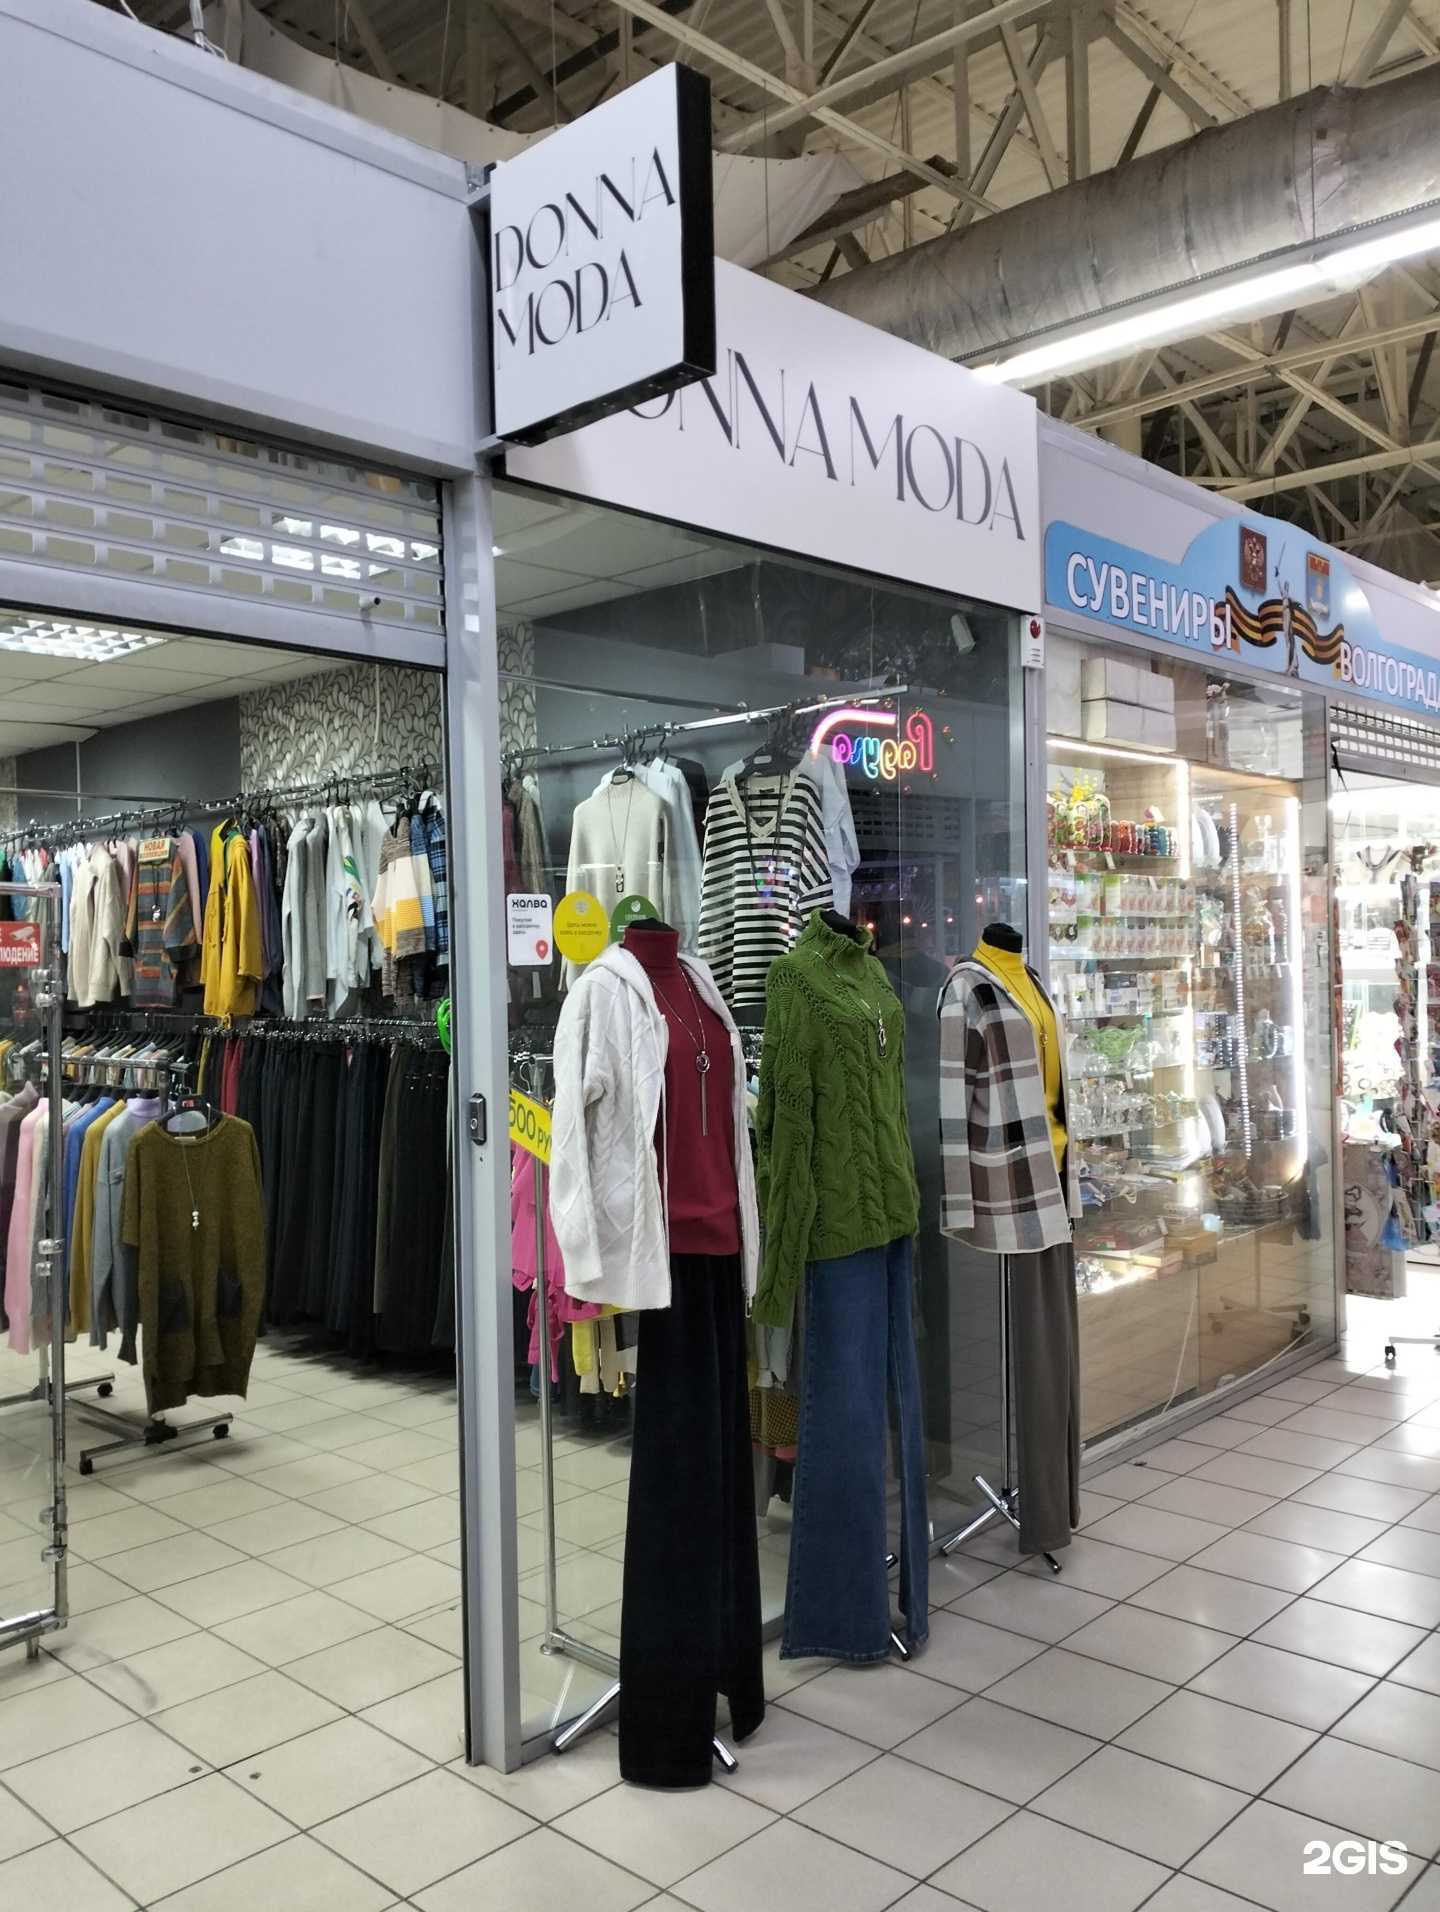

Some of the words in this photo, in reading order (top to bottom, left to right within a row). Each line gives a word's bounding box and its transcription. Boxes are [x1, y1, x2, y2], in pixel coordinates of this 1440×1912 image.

[495, 146, 676, 293] DONNA
[497, 247, 643, 370] MODA
[628, 347, 838, 481] NNA
[850, 394, 1026, 541] MODA
[1067, 551, 1233, 650] СУВЕНИРЫ
